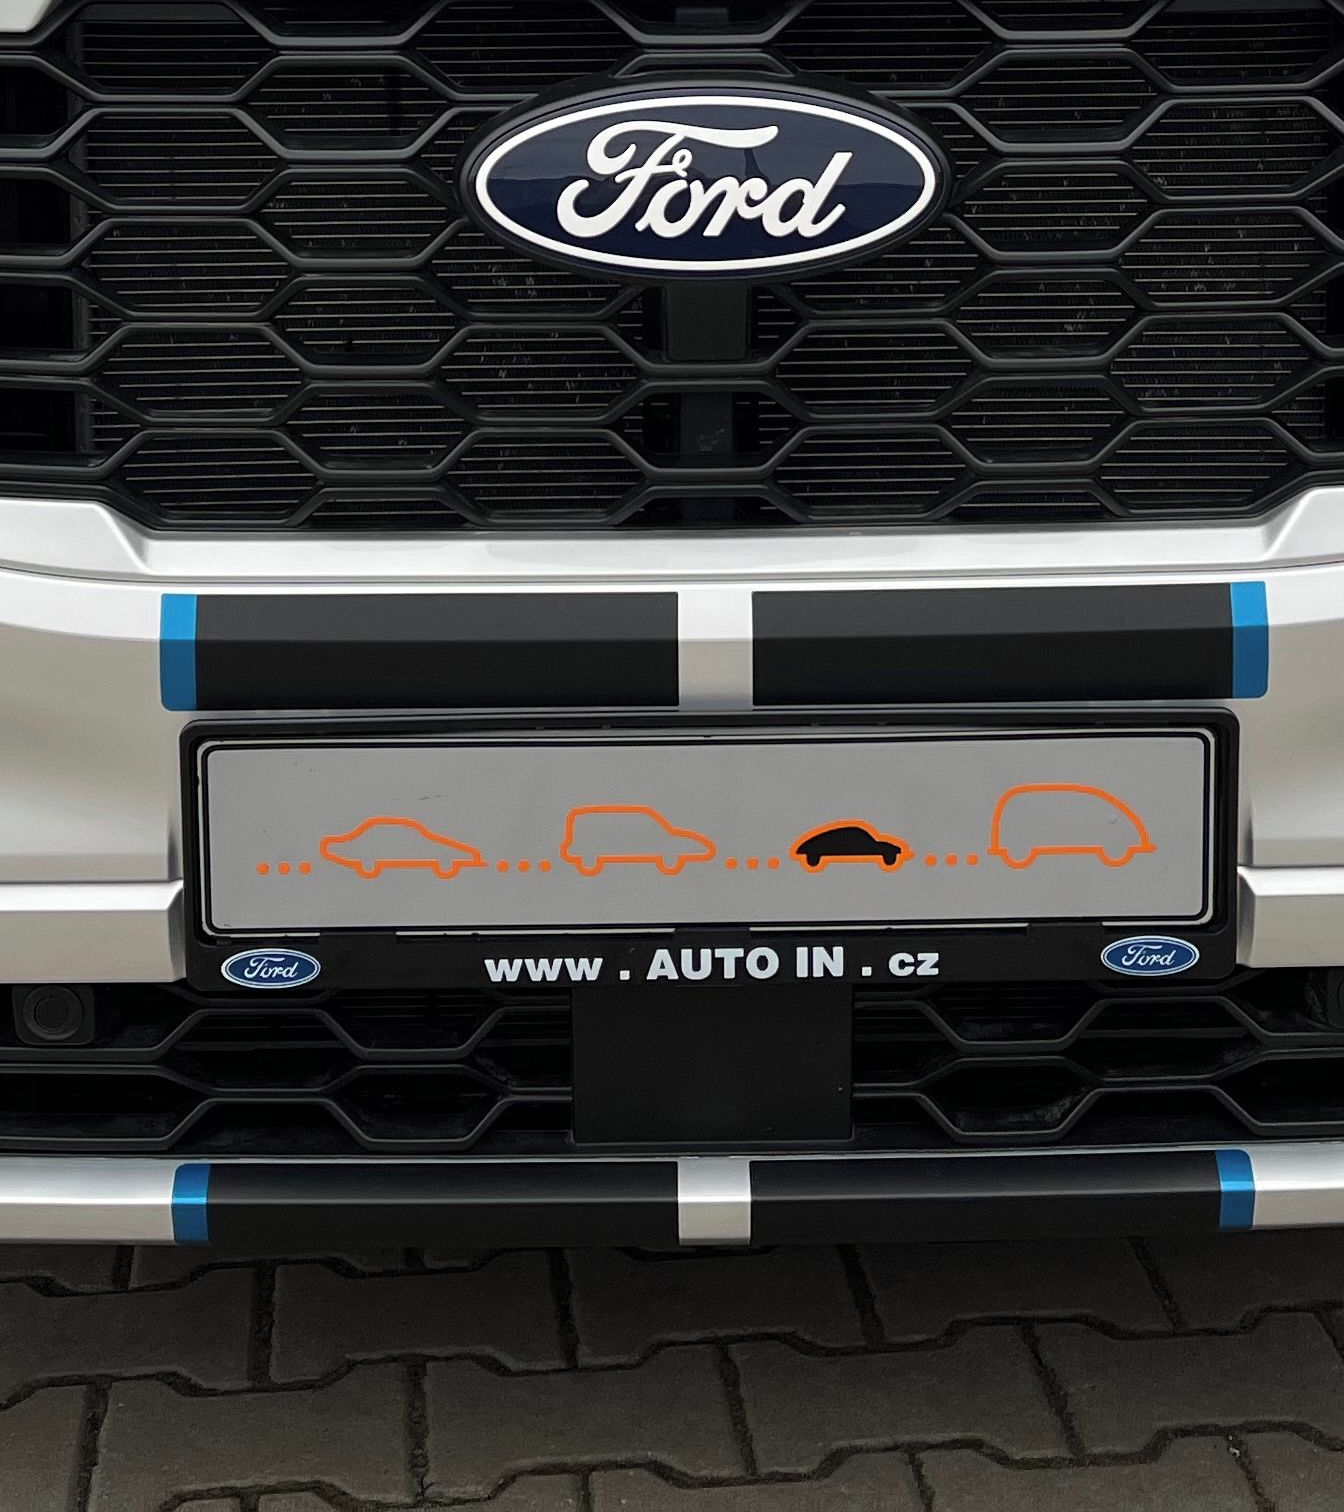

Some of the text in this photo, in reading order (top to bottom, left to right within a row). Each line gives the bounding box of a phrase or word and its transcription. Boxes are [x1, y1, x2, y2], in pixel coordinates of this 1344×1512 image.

[556, 120, 853, 238] Ford
[244, 956, 299, 979] Ford
[484, 957, 604, 982] www
[646, 946, 780, 981] AUTO
[796, 945, 844, 978] IN
[888, 952, 939, 977] cz
[1121, 944, 1177, 966] Ford
